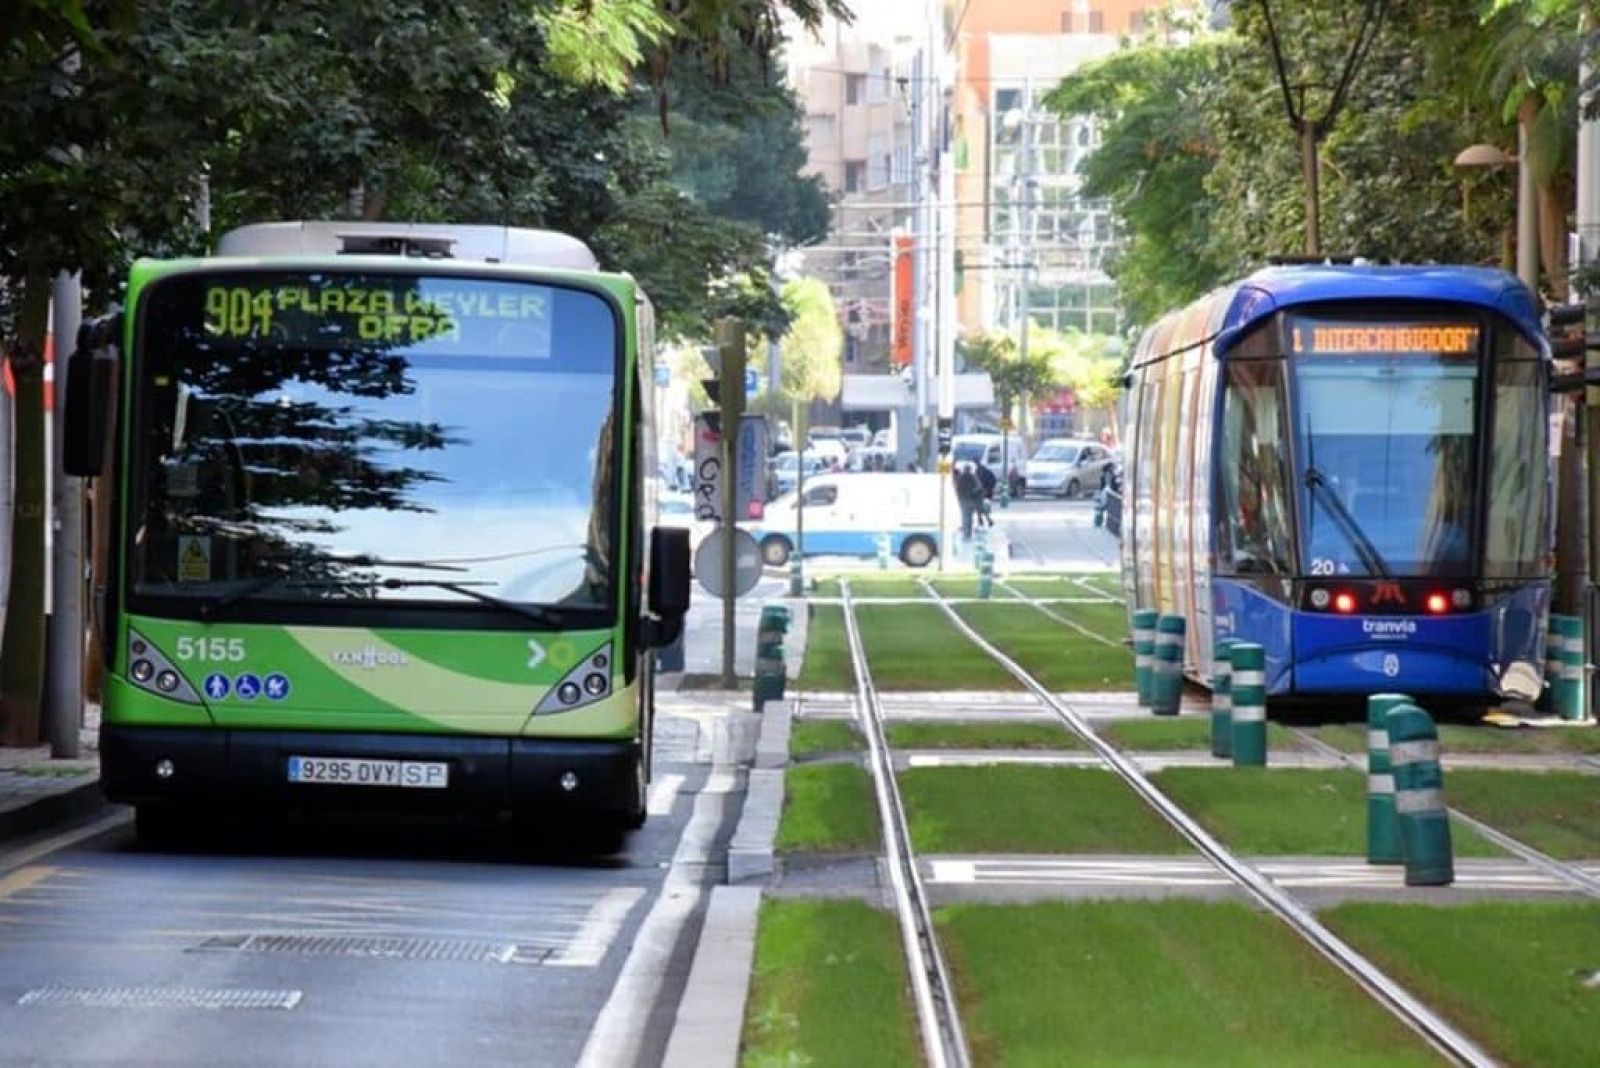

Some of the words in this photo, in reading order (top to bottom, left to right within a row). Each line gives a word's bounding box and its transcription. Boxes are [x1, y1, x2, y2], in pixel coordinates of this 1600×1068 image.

[206, 287, 273, 336] 904
[277, 288, 393, 314] PLAZA
[404, 289, 545, 318] WEYLER
[358, 315, 459, 342] OFRA
[1311, 559, 1334, 576] 20
[177, 637, 245, 661] 5155
[303, 760, 352, 782] 9295
